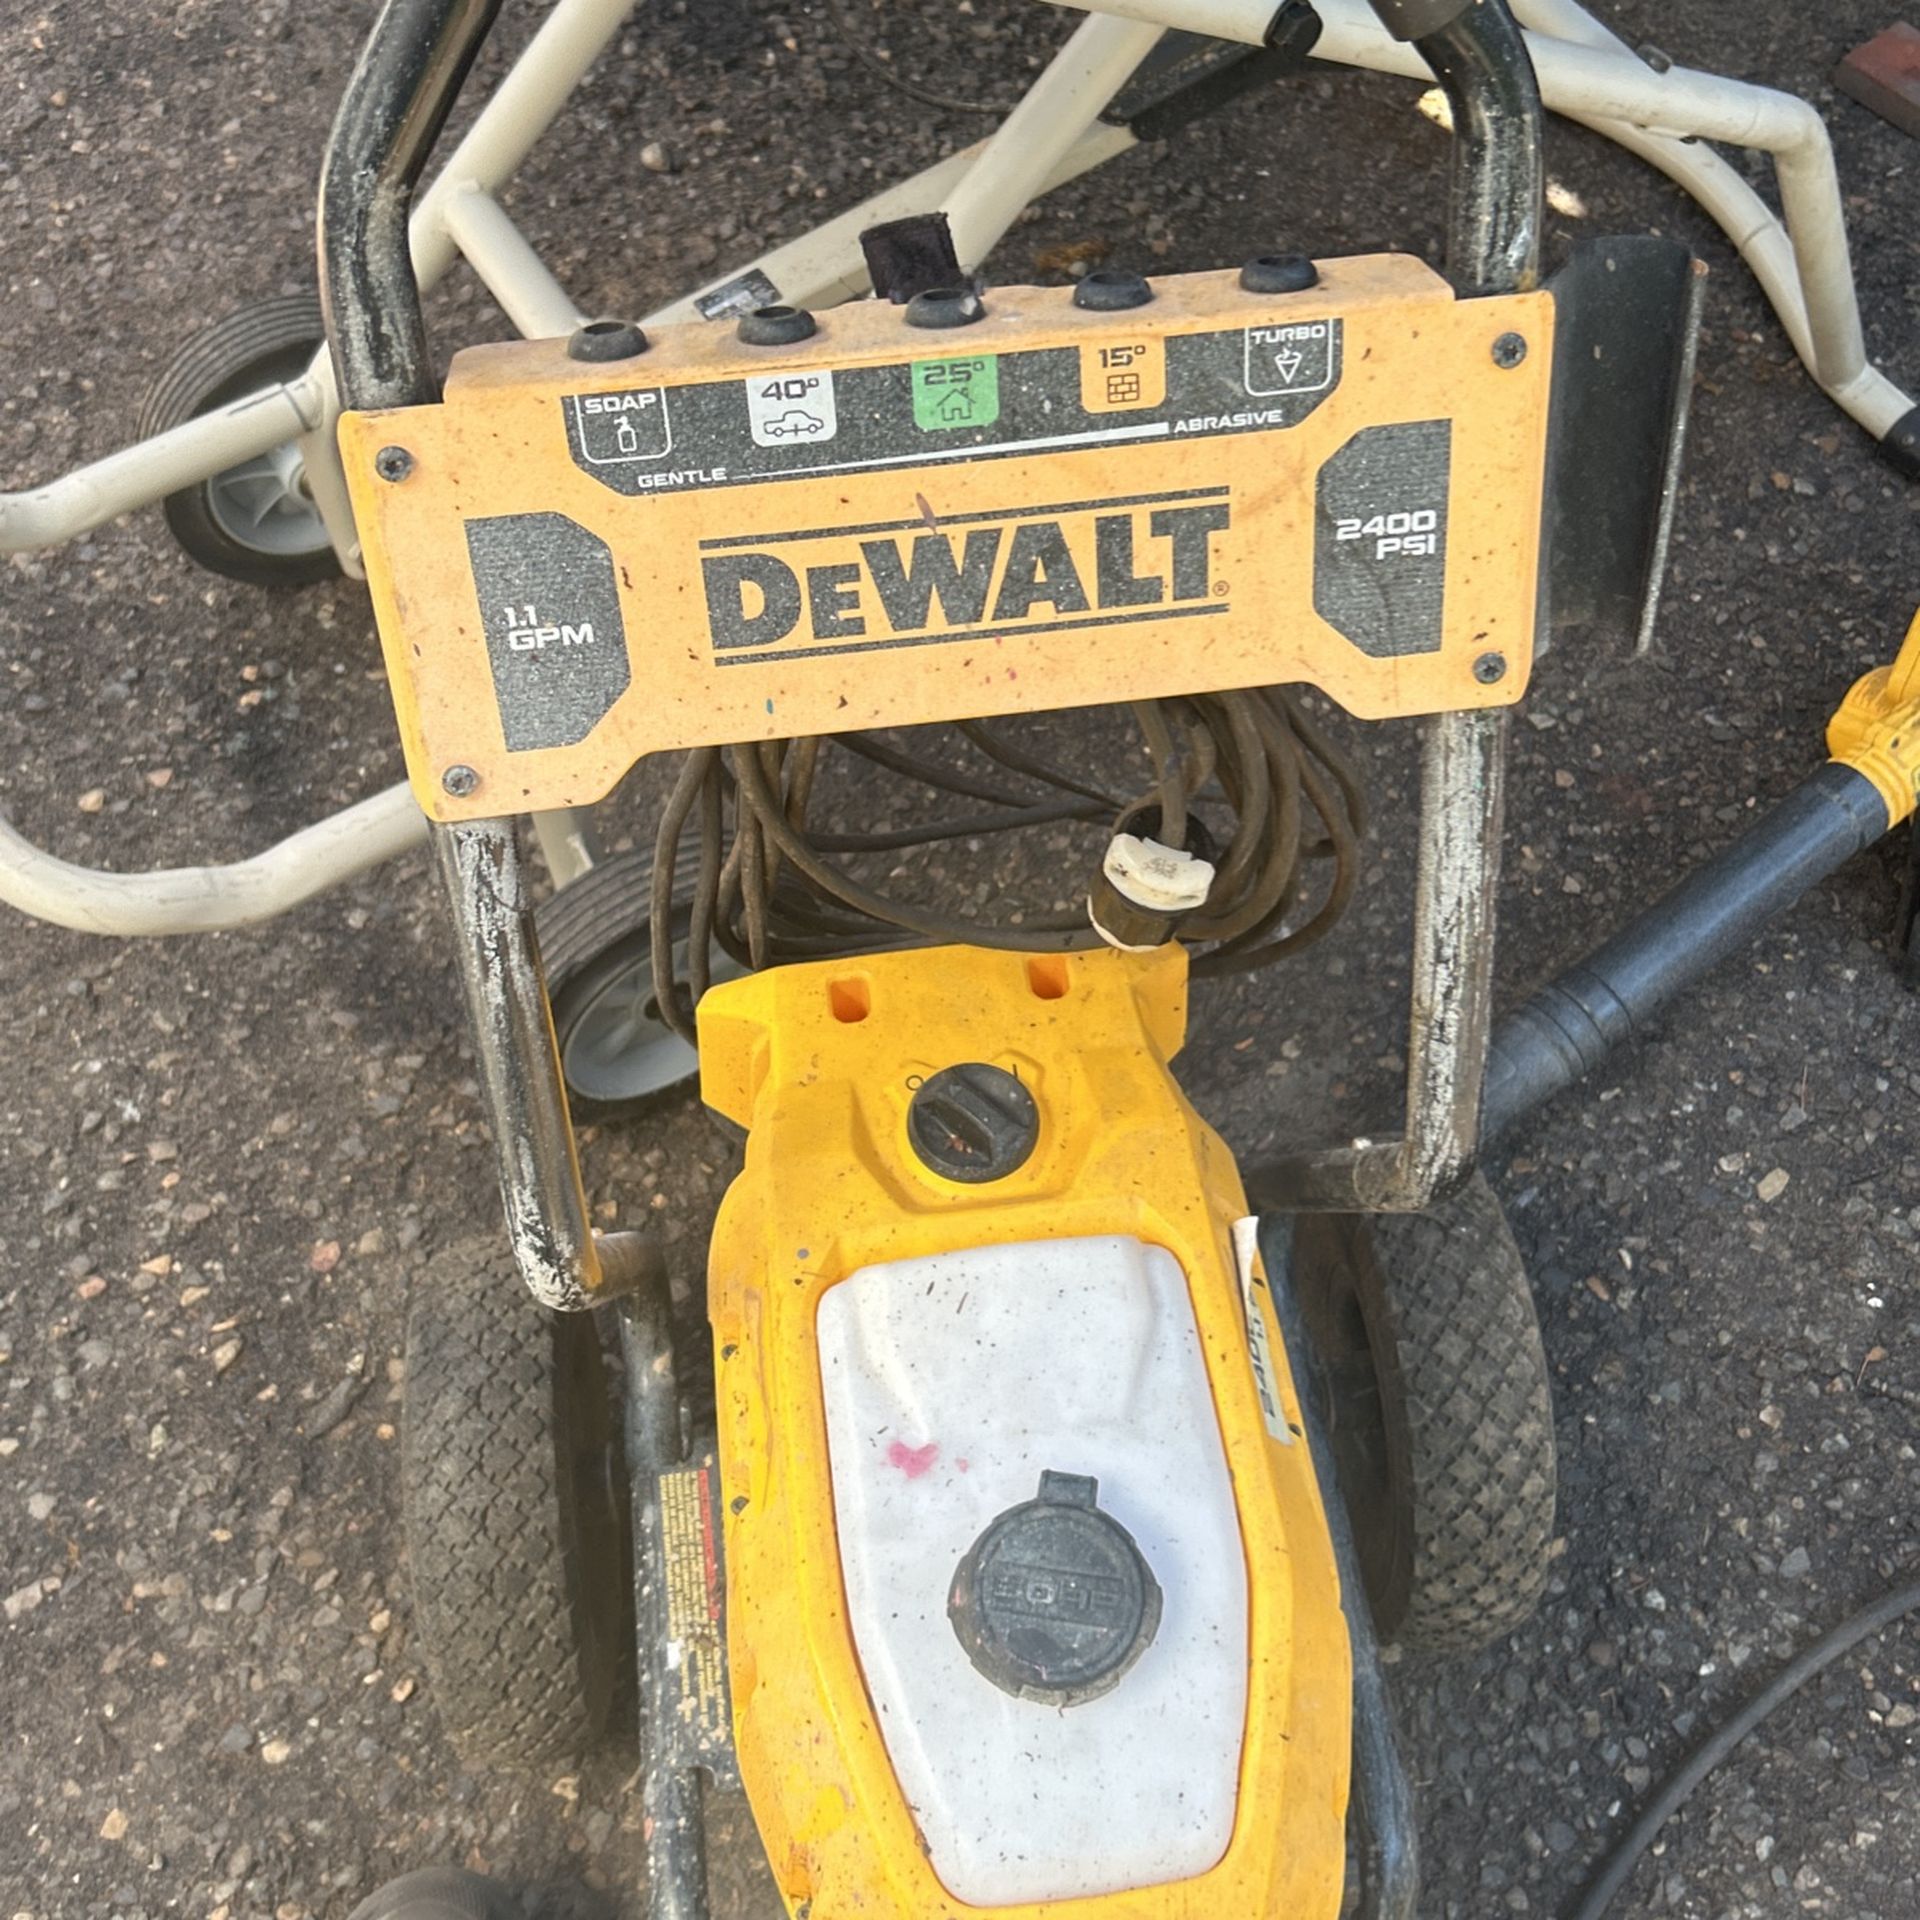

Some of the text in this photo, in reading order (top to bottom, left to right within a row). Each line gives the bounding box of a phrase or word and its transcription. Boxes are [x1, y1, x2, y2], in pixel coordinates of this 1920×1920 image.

[1250, 324, 1327, 345] TURBO
[923, 361, 985, 386] 25°
[584, 393, 657, 415] SOAP
[1173, 409, 1283, 433] ABRASIVE
[637, 467, 728, 489] GENTLE
[1336, 510, 1436, 541] 2400
[1376, 533, 1436, 561] PSI
[503, 605, 538, 629] 1.1
[508, 623, 595, 652] GPM
